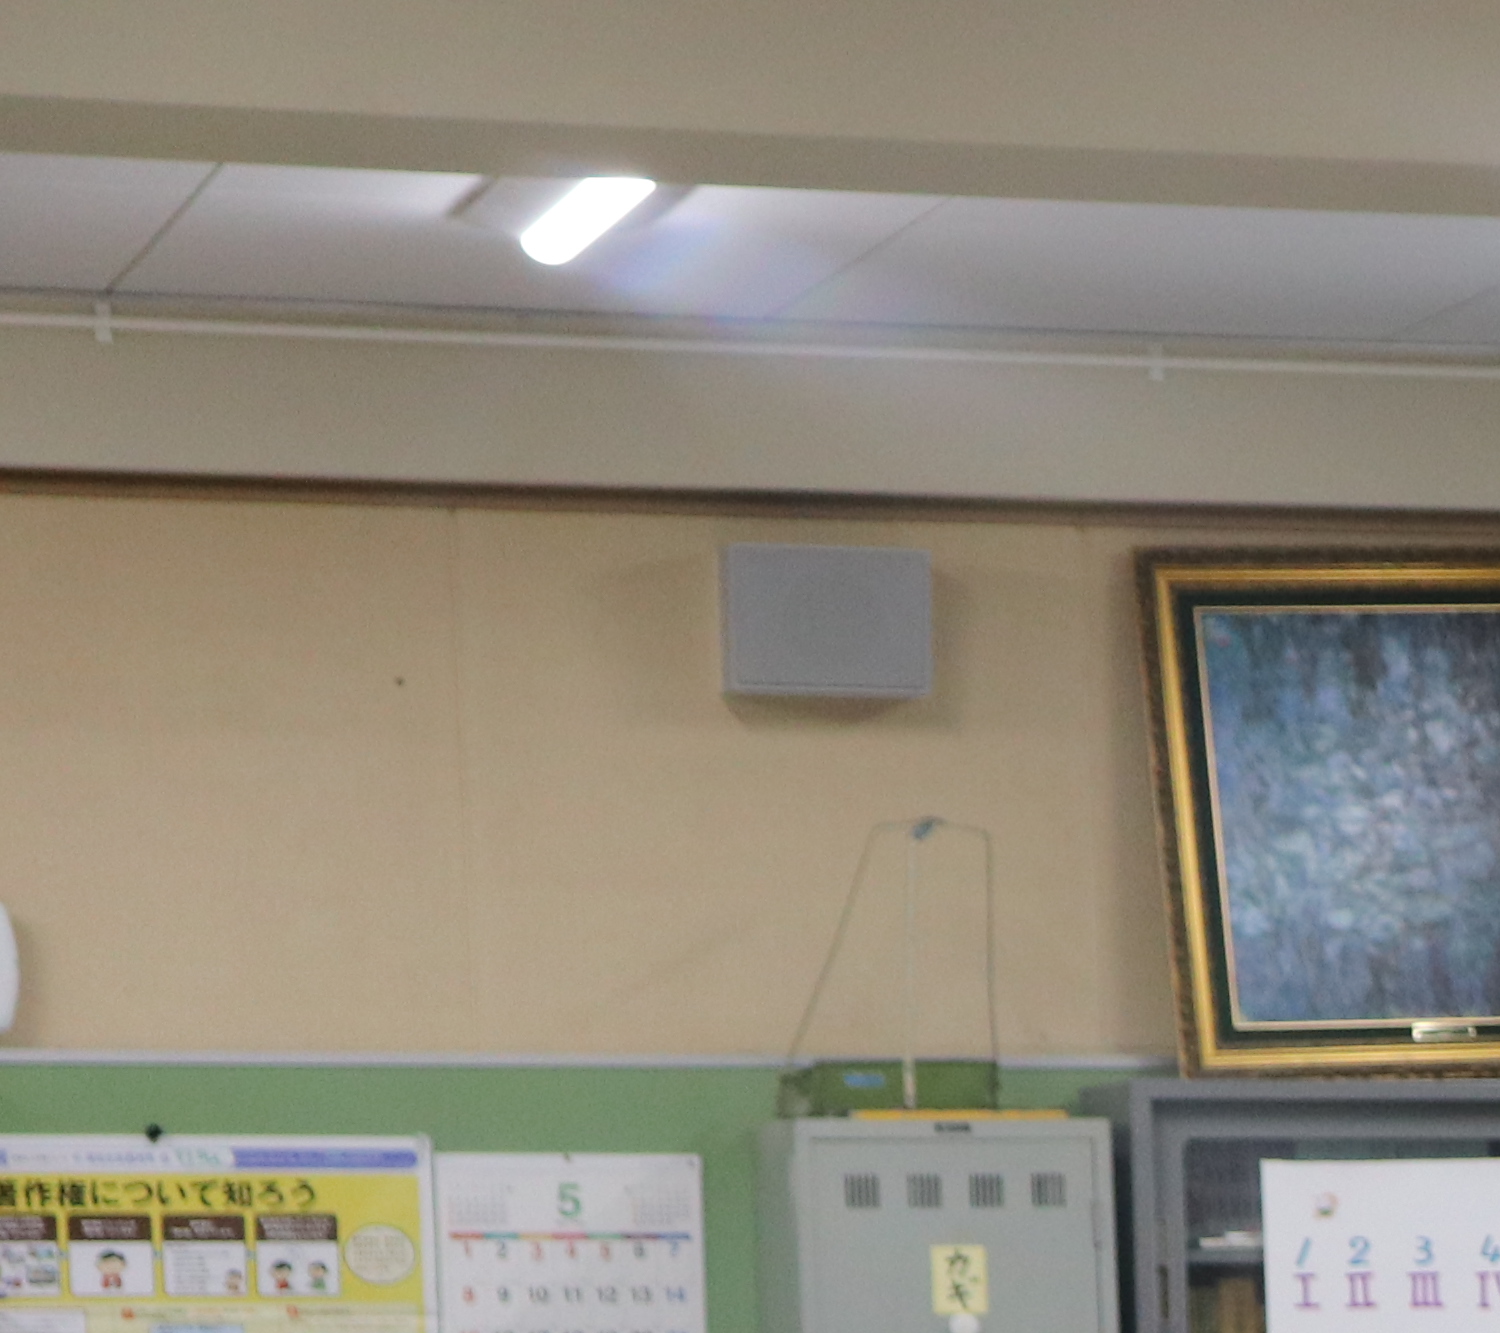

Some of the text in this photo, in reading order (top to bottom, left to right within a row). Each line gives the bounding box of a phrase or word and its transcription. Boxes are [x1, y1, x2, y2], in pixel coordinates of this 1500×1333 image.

[558, 1183, 582, 1217] 5
[1296, 1237, 1312, 1267] 1
[1348, 1235, 1371, 1266] 2
[1415, 1235, 1434, 1265] 3
[463, 1286, 686, 1303] 8 9 10 11 12 13 14
